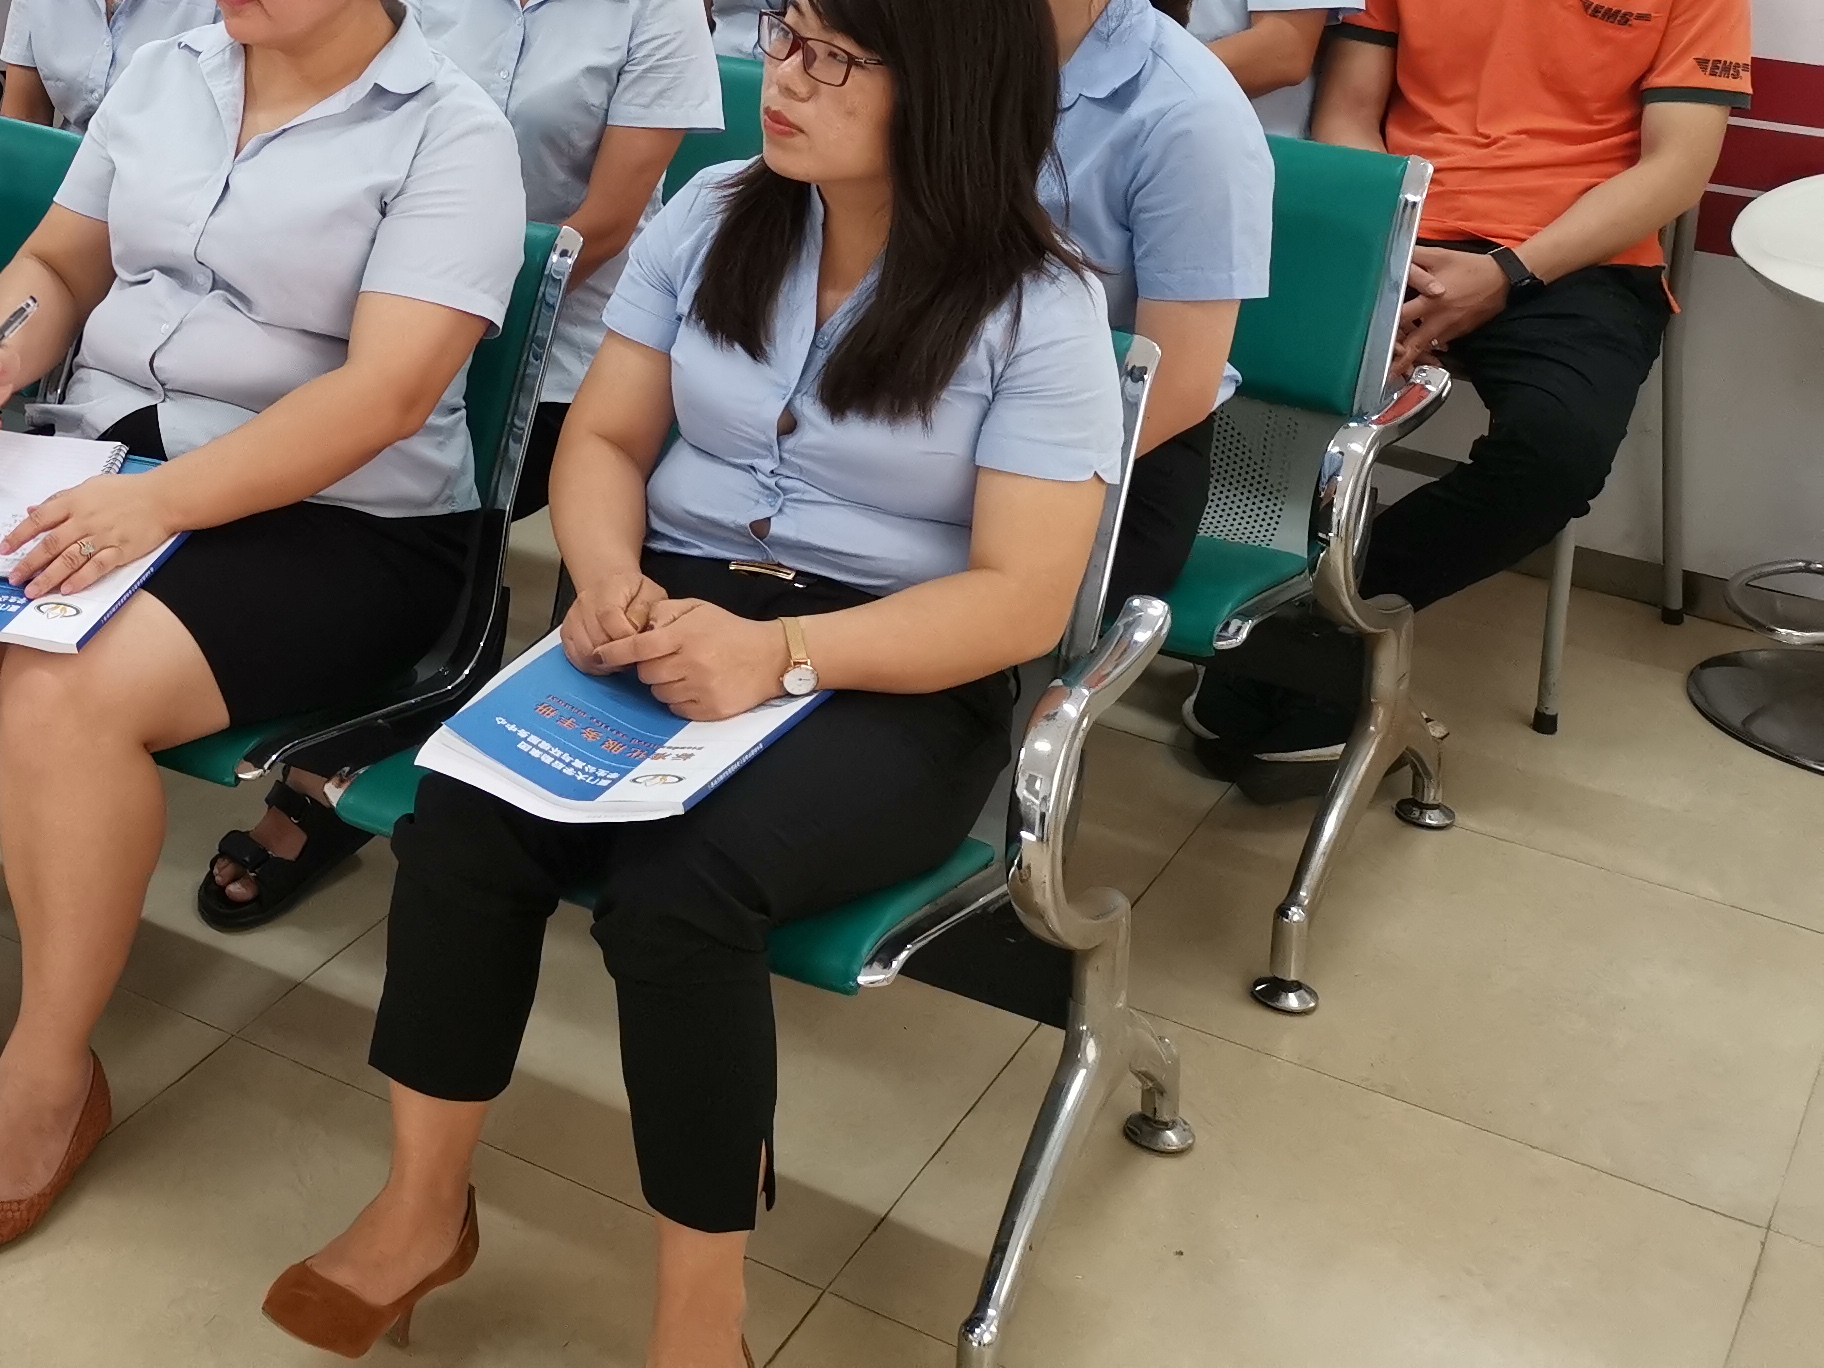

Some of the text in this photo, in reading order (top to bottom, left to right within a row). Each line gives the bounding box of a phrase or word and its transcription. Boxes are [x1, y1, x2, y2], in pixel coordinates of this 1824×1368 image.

[1589, 3, 1634, 27] EMS
[1708, 58, 1742, 80] EMS
[533, 702, 696, 763] 标准化服务手册
